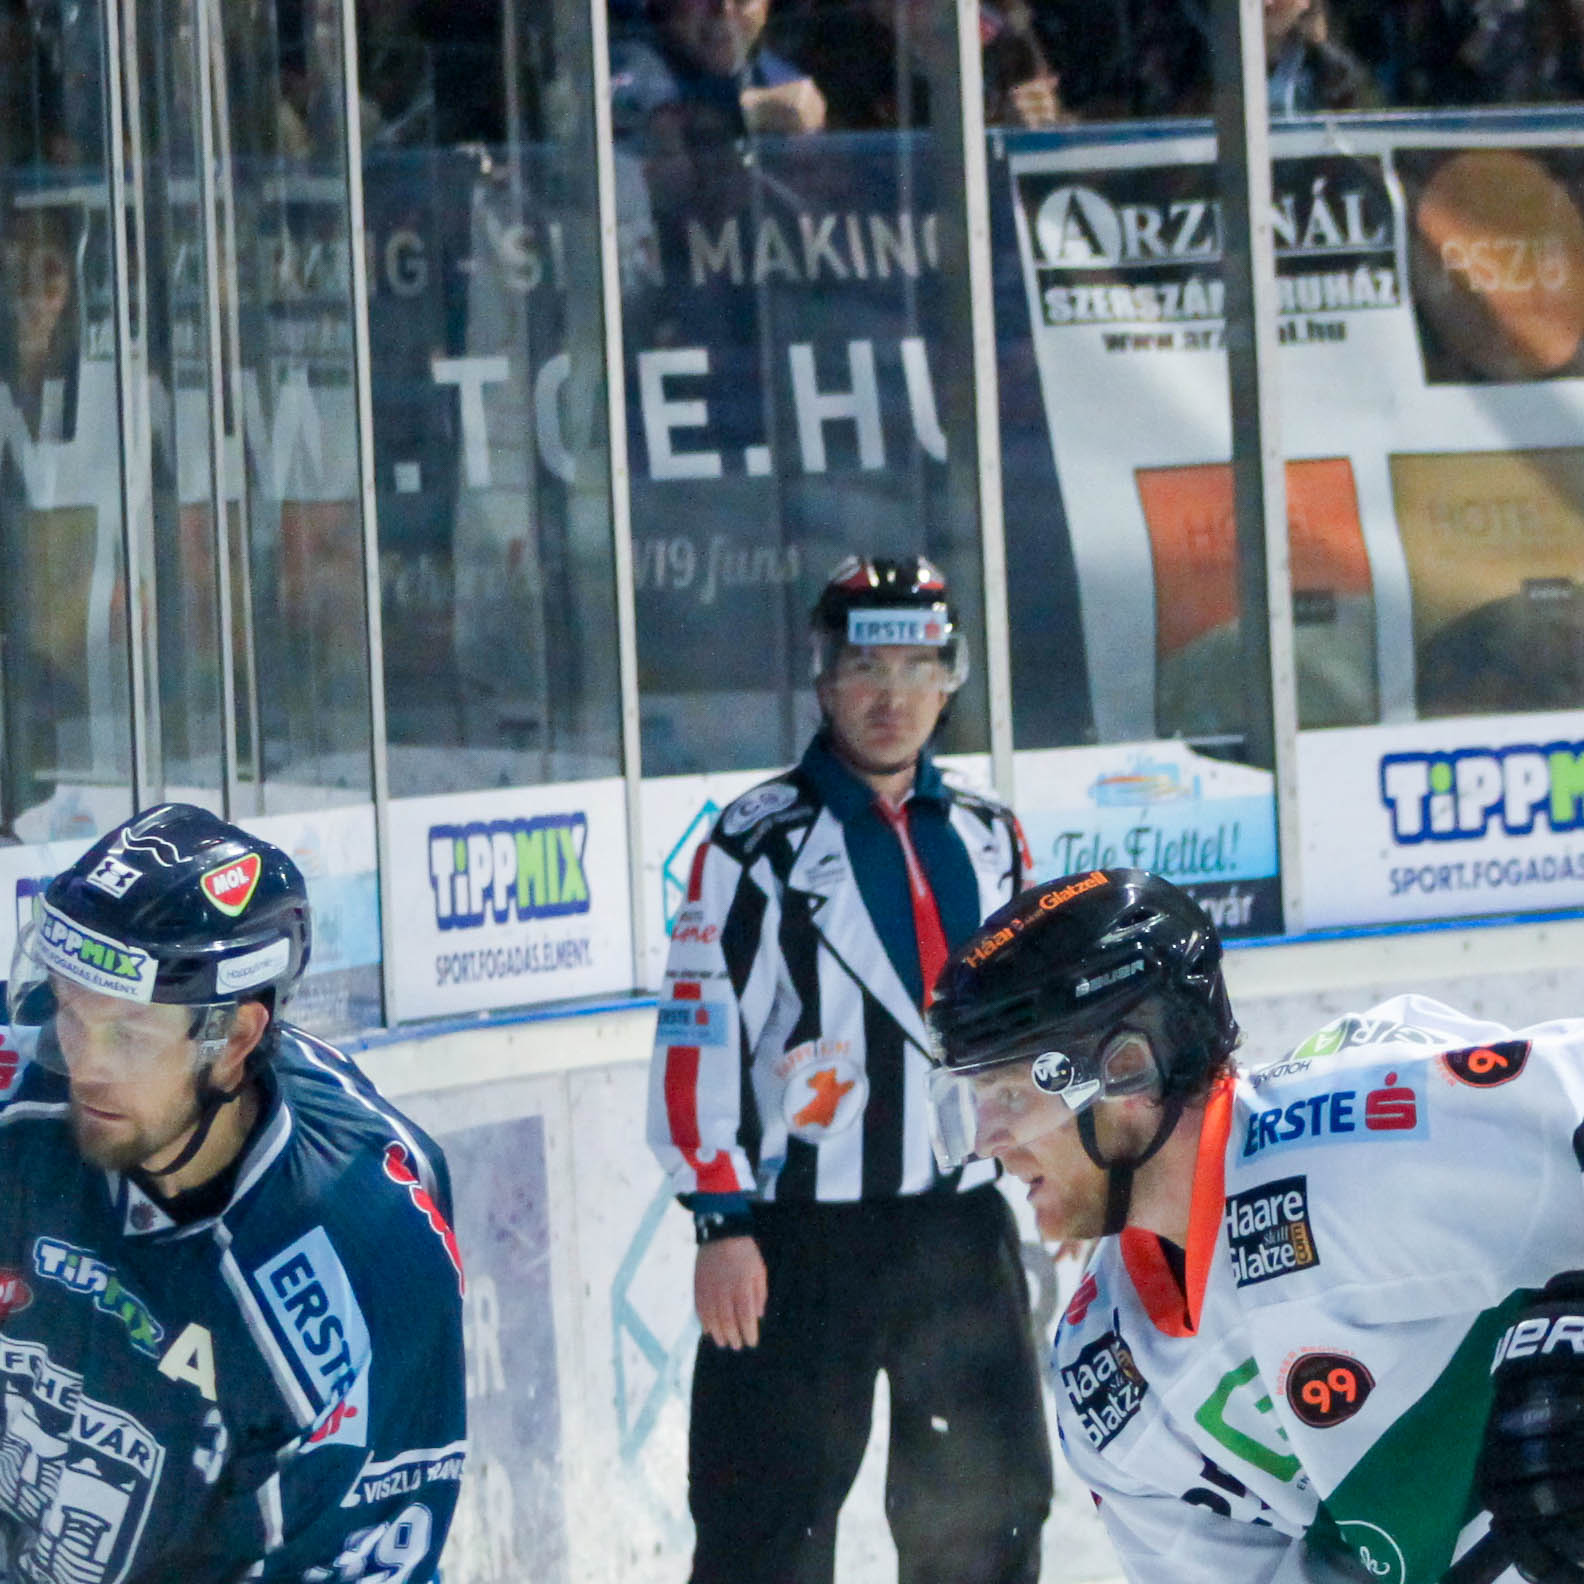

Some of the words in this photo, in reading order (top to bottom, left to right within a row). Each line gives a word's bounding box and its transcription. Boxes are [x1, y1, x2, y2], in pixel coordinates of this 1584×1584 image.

[1036, 178, 1386, 262] ARZNÁL
[212, 866, 250, 896] MOL
[1242, 1091, 1356, 1158] ERSTE
[157, 1322, 218, 1402] A
[1302, 1368, 1357, 1414] 99
